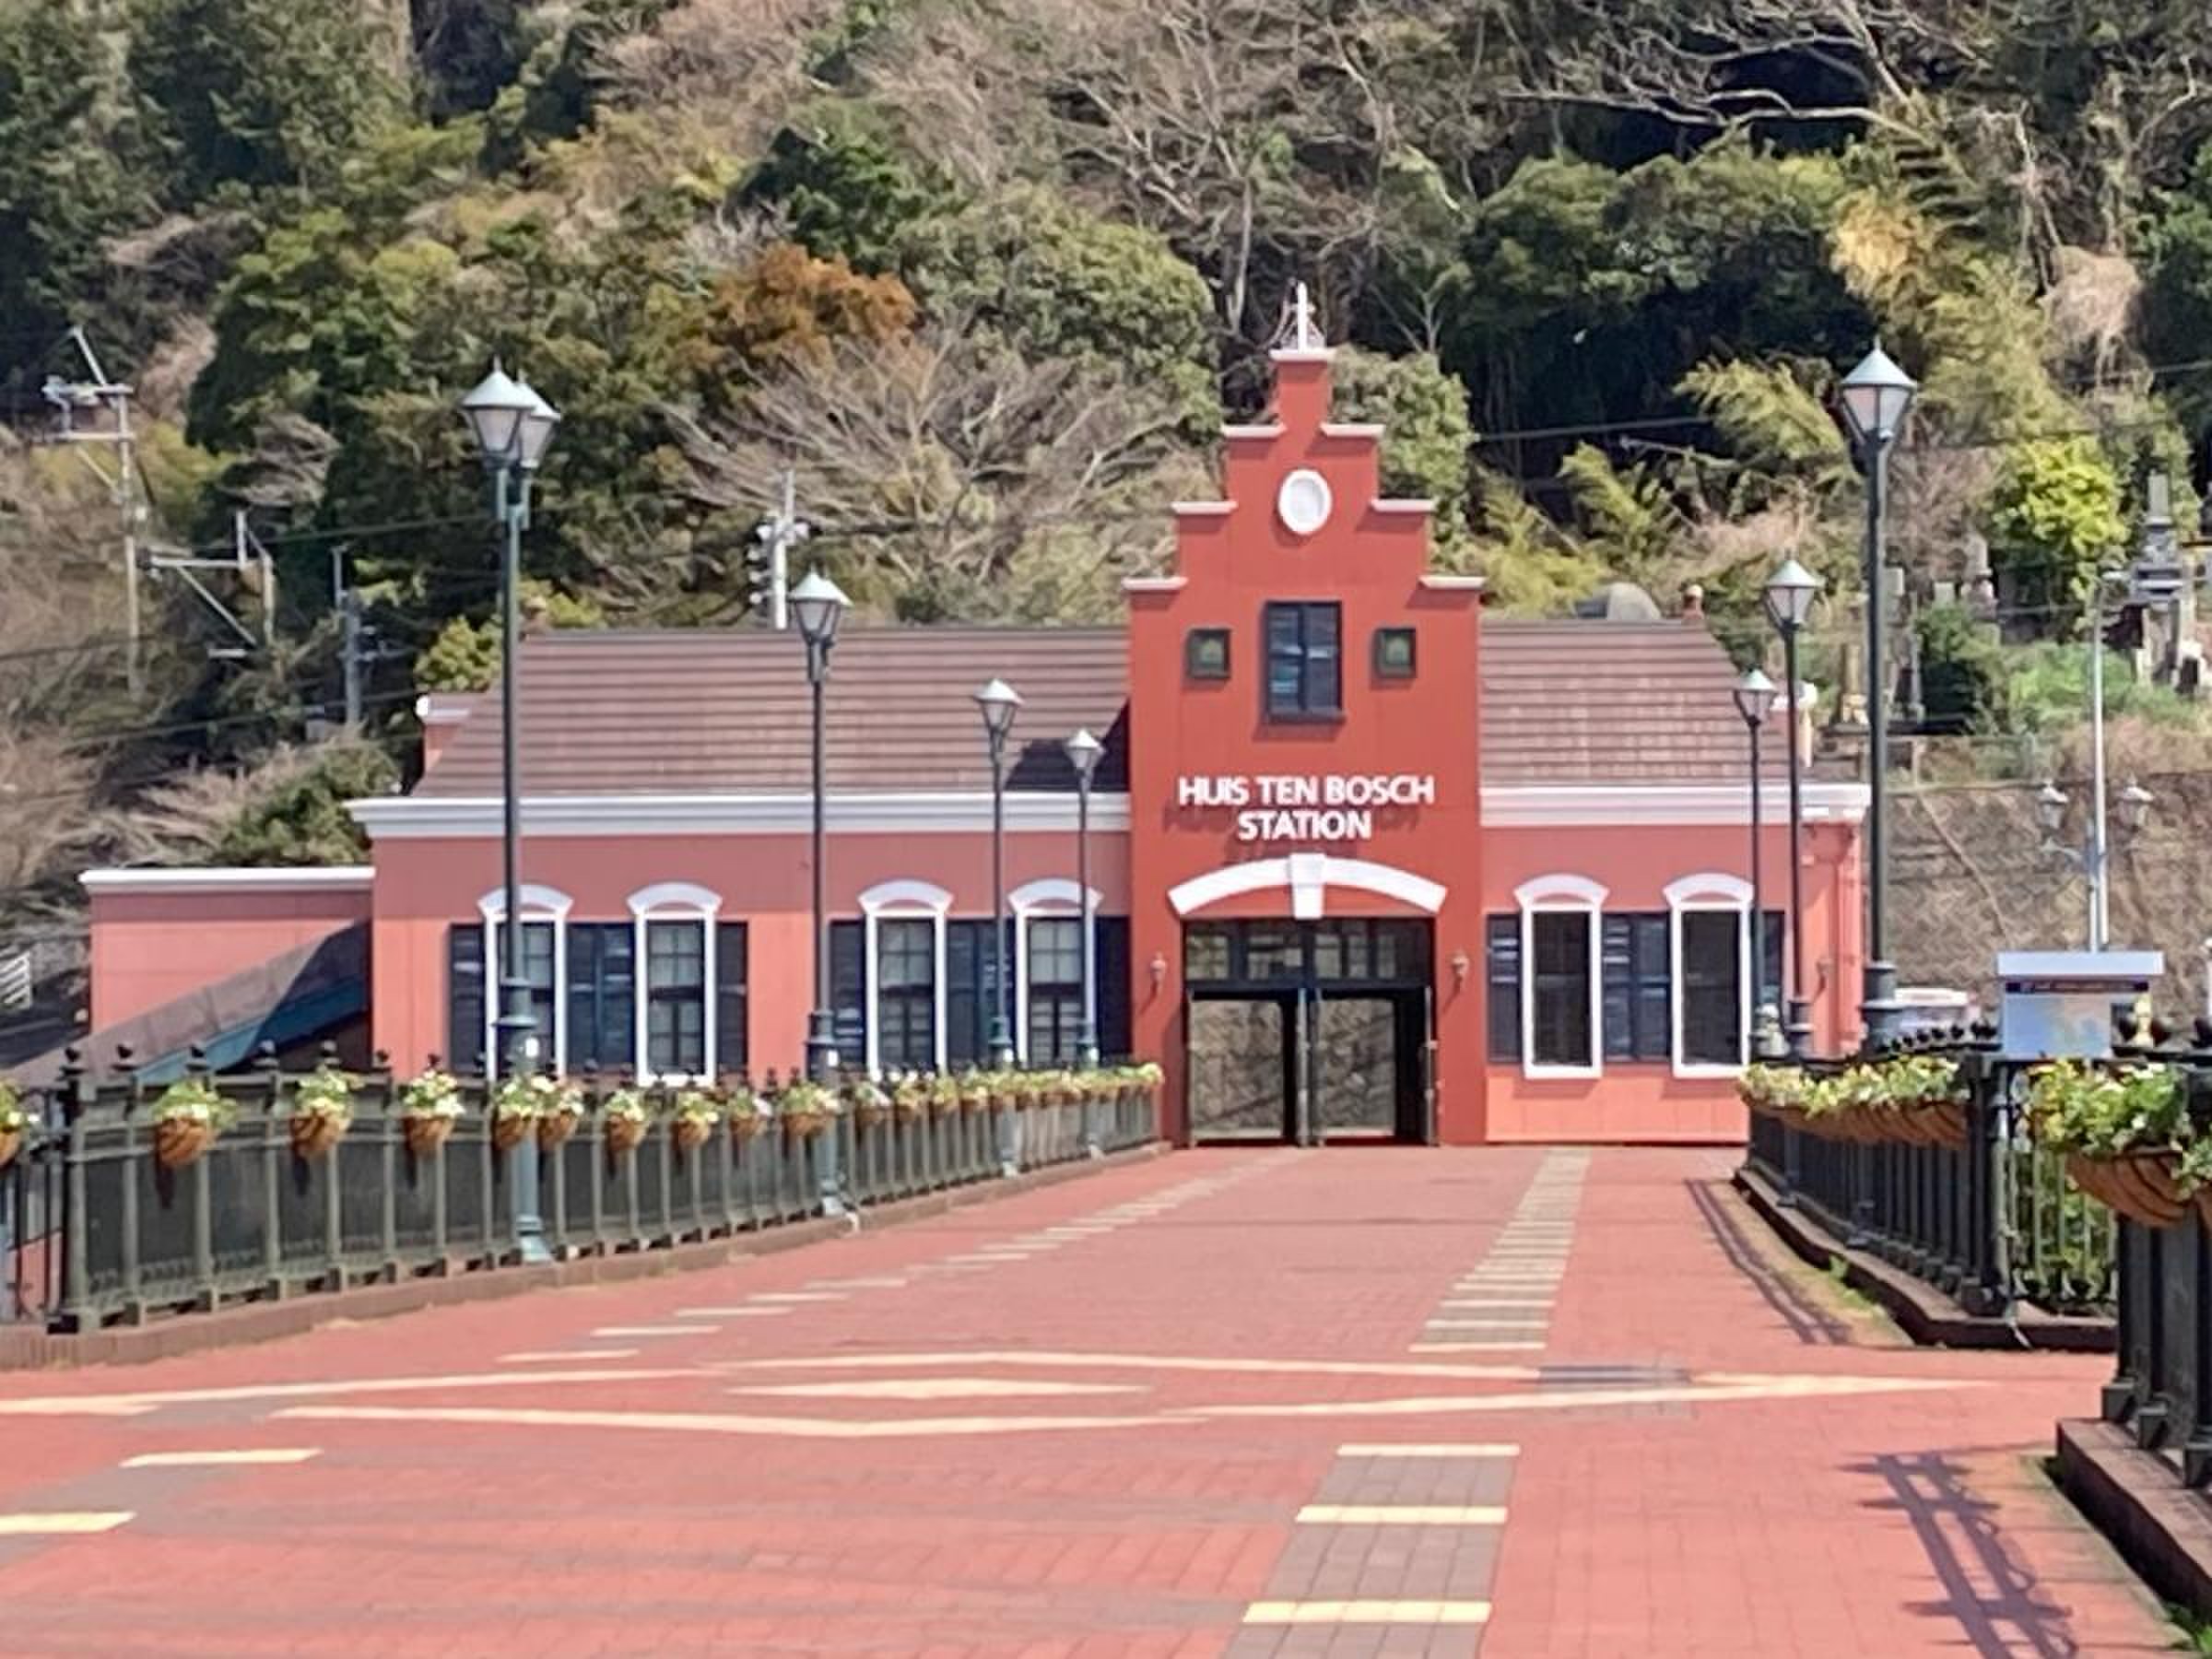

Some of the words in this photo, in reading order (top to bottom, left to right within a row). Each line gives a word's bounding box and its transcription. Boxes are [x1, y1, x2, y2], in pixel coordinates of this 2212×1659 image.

[1179, 775, 1250, 805] HUIS
[1255, 775, 1318, 805] TEN
[1324, 775, 1435, 805] BOSCH
[1238, 810, 1372, 840] STATION
